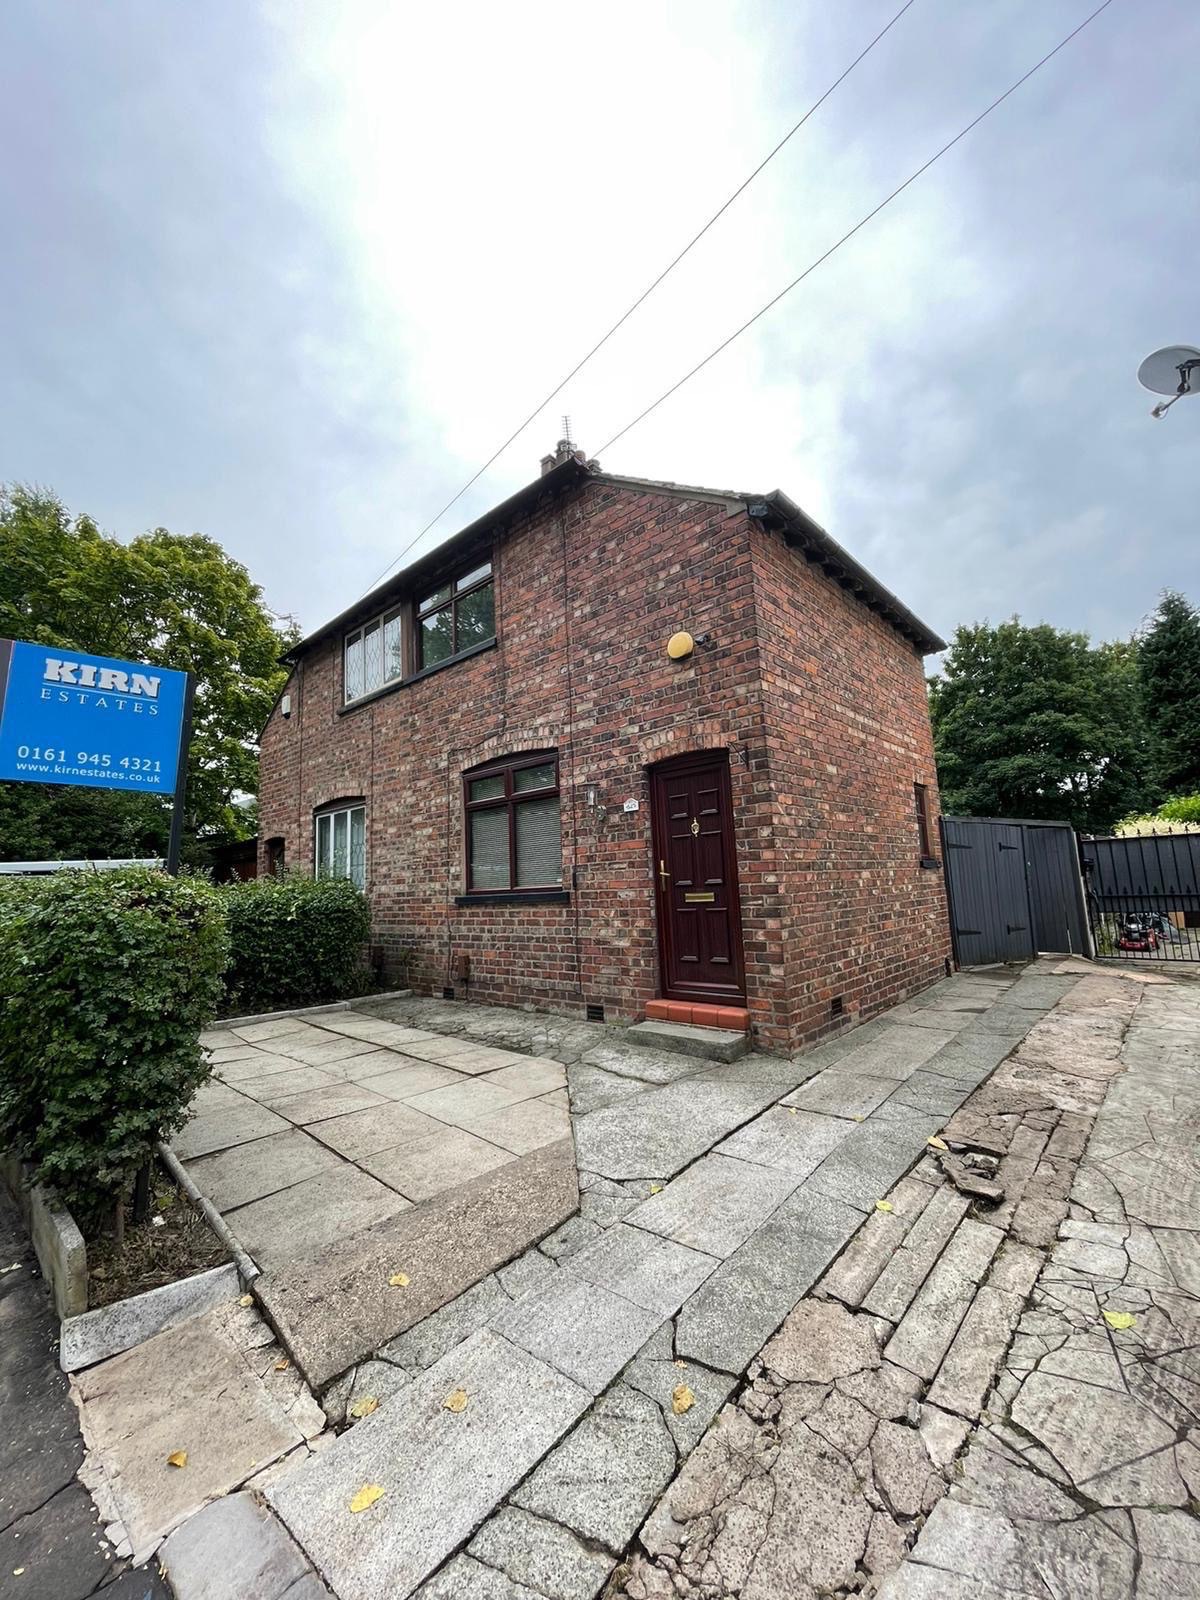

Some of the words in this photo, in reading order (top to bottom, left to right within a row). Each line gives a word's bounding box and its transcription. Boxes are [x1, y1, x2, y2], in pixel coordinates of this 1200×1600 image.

[44, 658, 161, 698] KIRN
[41, 688, 158, 715] ESTATES
[18, 745, 66, 762] 0161
[77, 752, 112, 766] 945
[119, 757, 161, 772] 4321
[16, 762, 160, 783] www.kirnestates.co.uk
